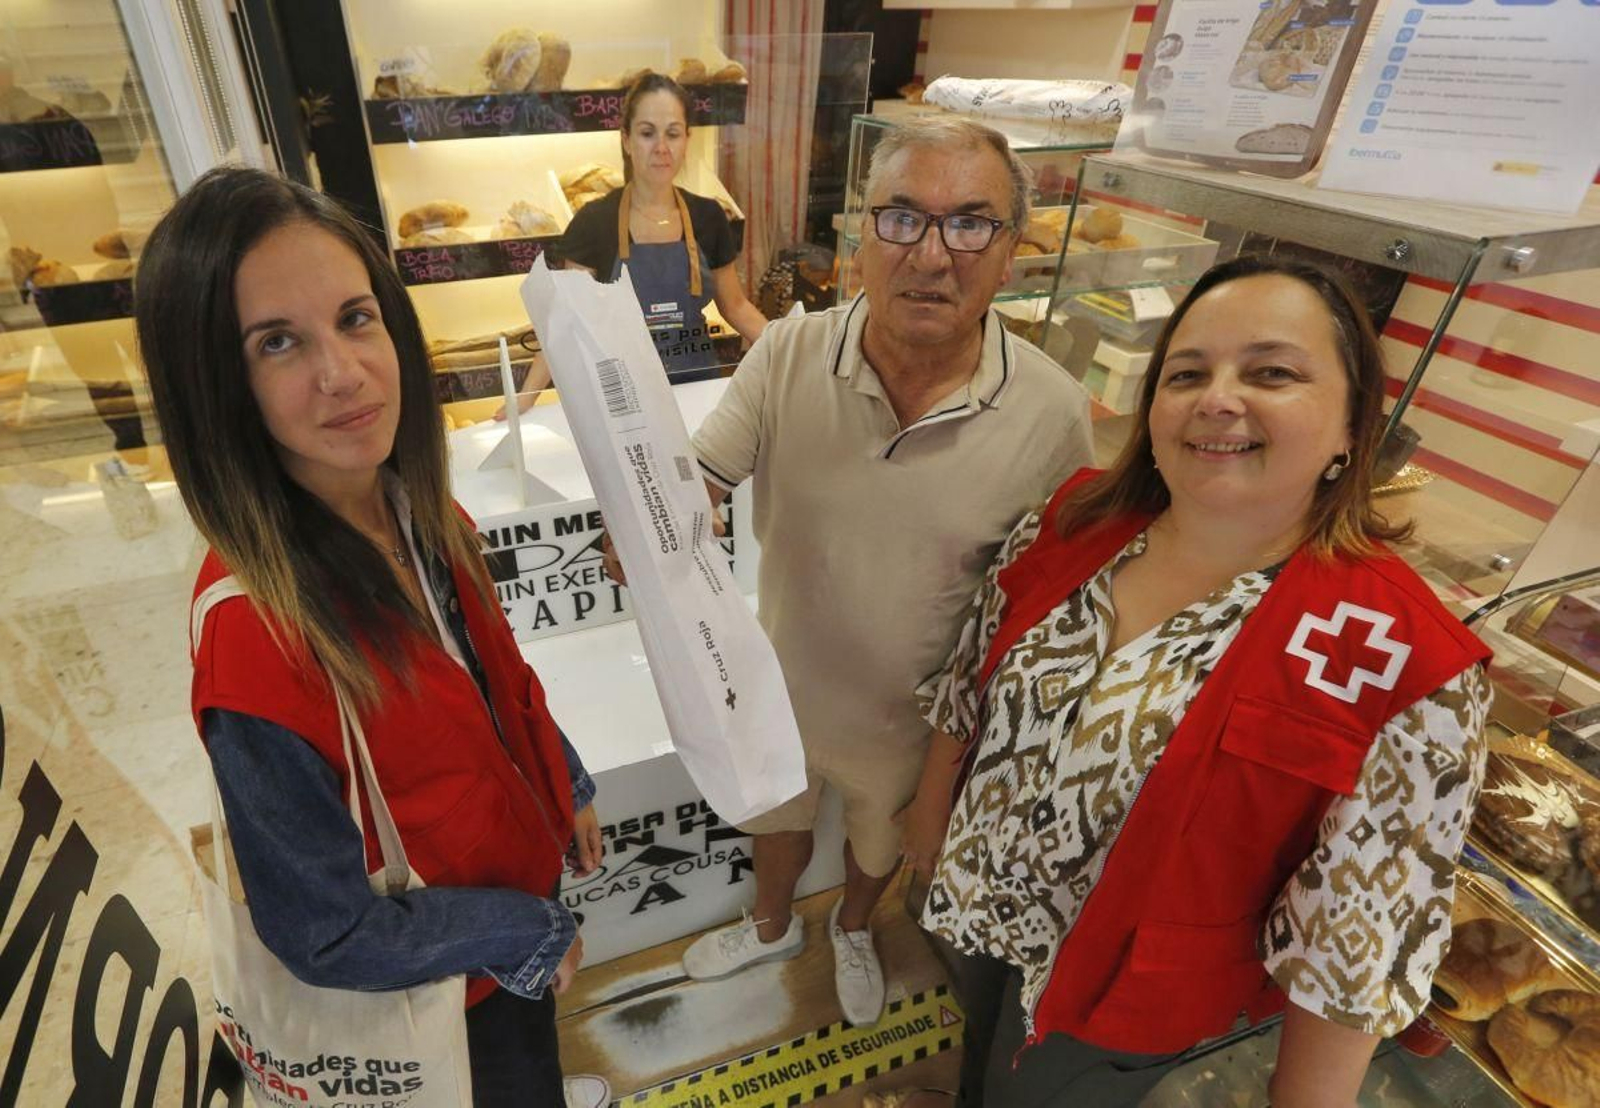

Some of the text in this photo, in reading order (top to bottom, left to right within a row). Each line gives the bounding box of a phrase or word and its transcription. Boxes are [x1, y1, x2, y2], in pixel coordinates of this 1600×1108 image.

[624, 445, 637, 467] que
[632, 443, 653, 483] vidas
[634, 468, 669, 554] Oportunidades
[650, 485, 678, 552] cambian
[699, 620, 729, 682] Cruz Roja
[565, 876, 641, 909] UCAS
[365, 1057, 421, 1077] que
[719, 1089, 731, 1106] A
[732, 1058, 817, 1100] DISTANCIA
[817, 1049, 840, 1069] DE
[841, 1014, 936, 1060] SEGURIDADE
[318, 1069, 424, 1098] vidas
